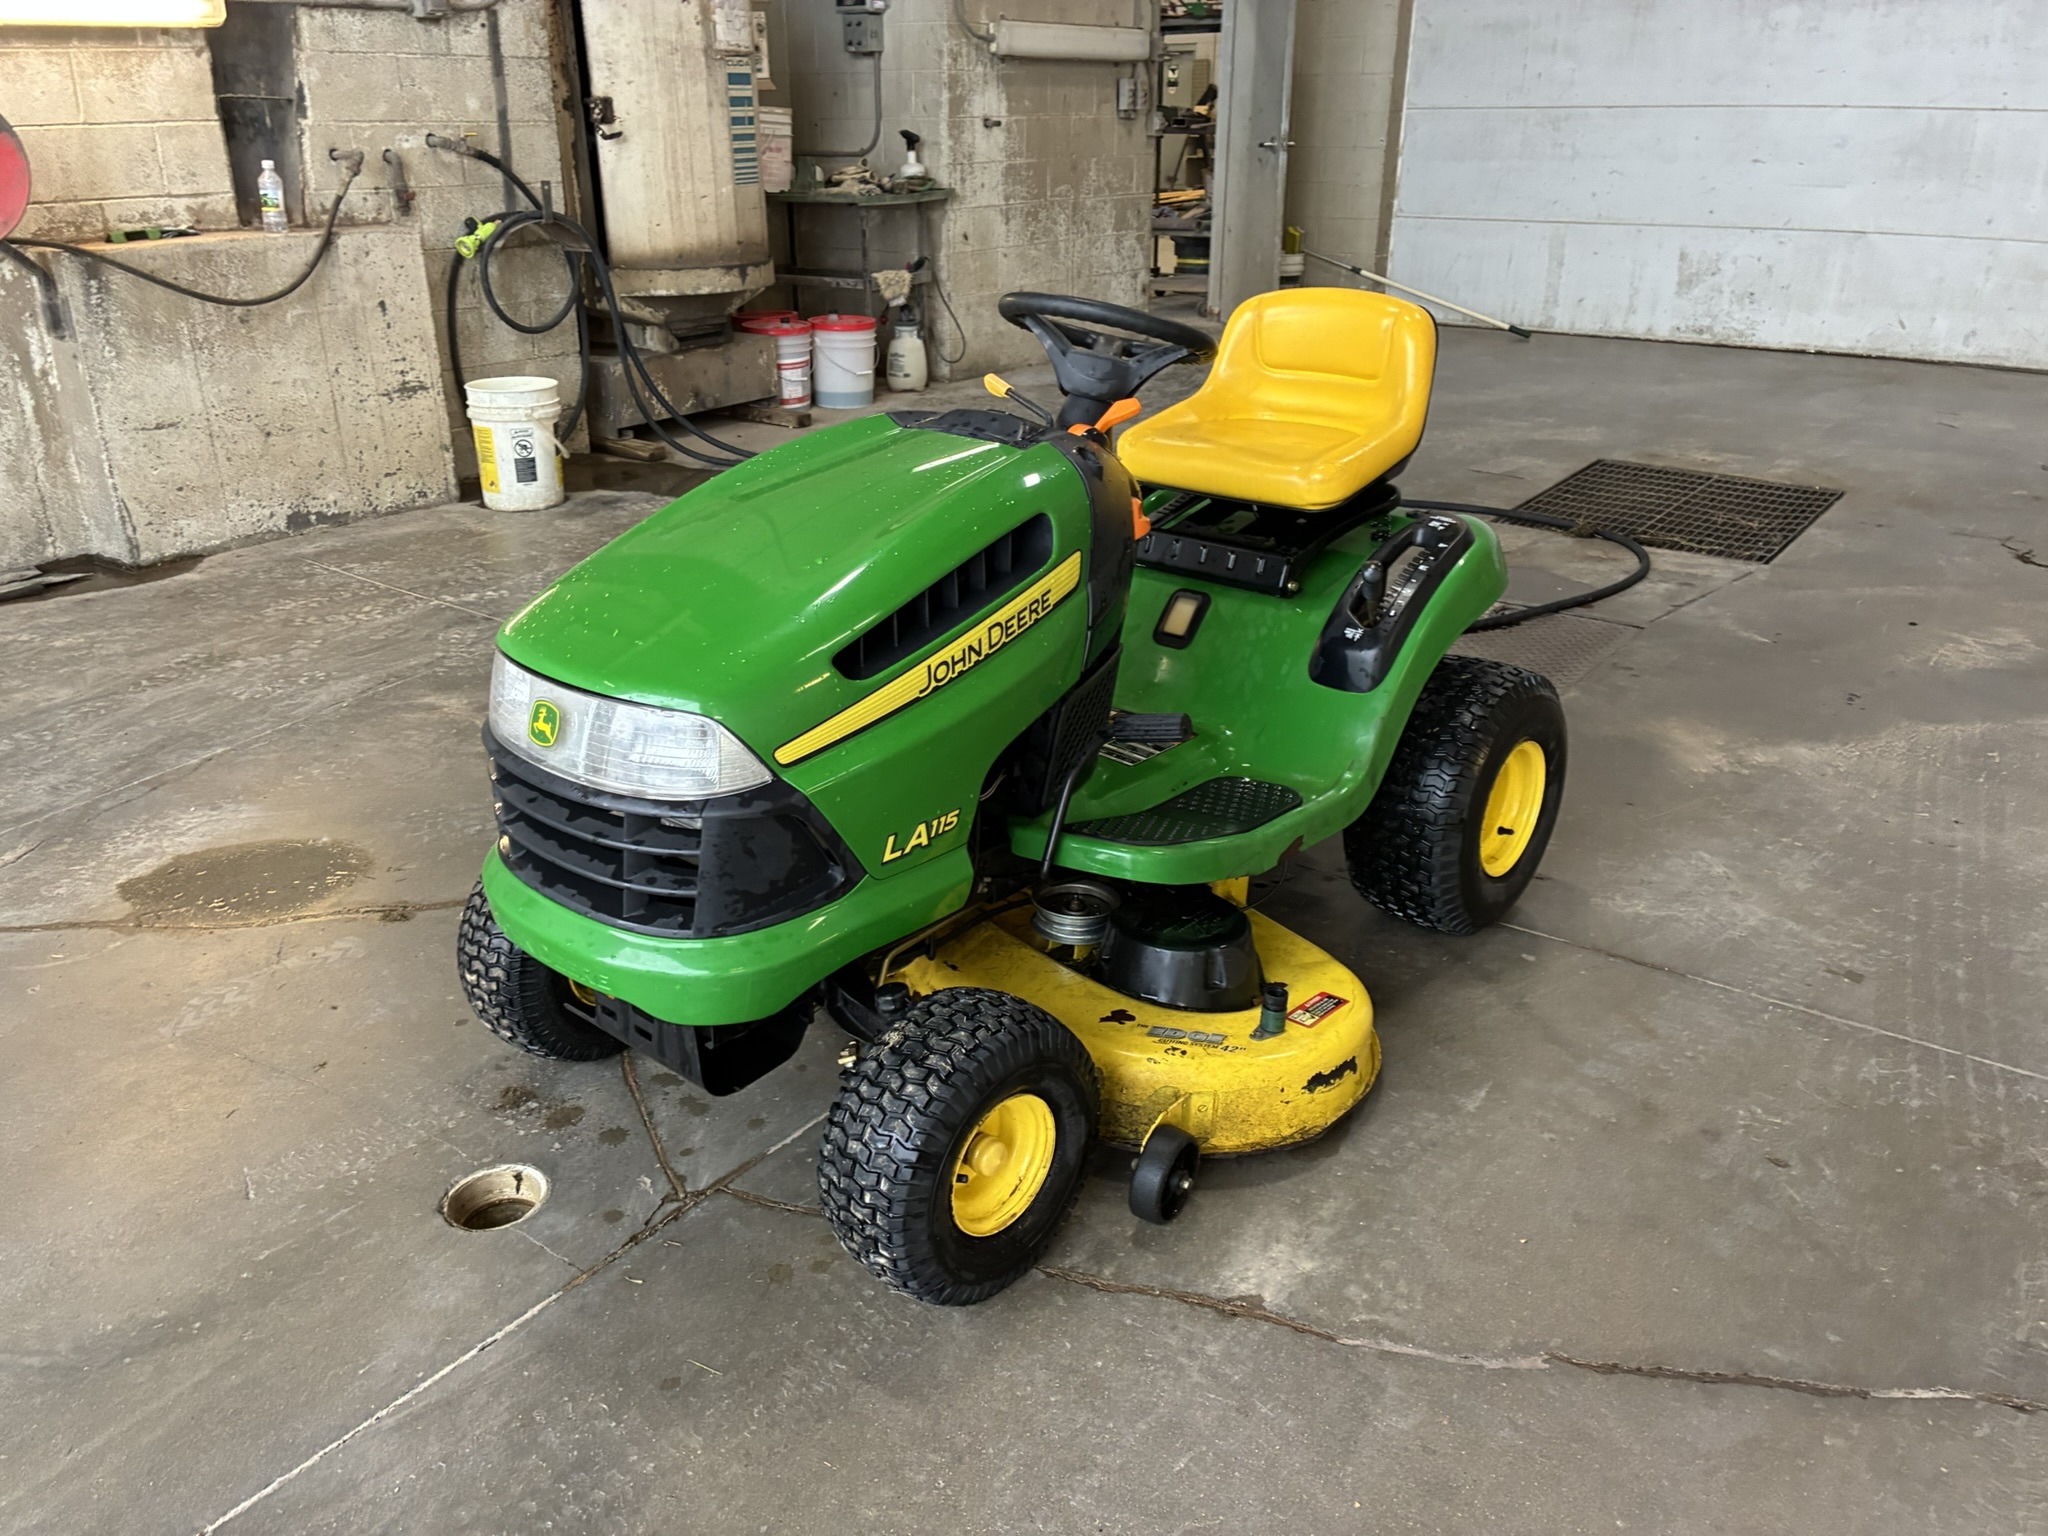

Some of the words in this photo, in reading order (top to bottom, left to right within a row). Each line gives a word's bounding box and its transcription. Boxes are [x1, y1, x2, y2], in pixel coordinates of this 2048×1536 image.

[919, 638, 982, 695] JOHN
[988, 589, 1052, 652] DEERE
[1189, 1042, 1219, 1050] SYSTEM
